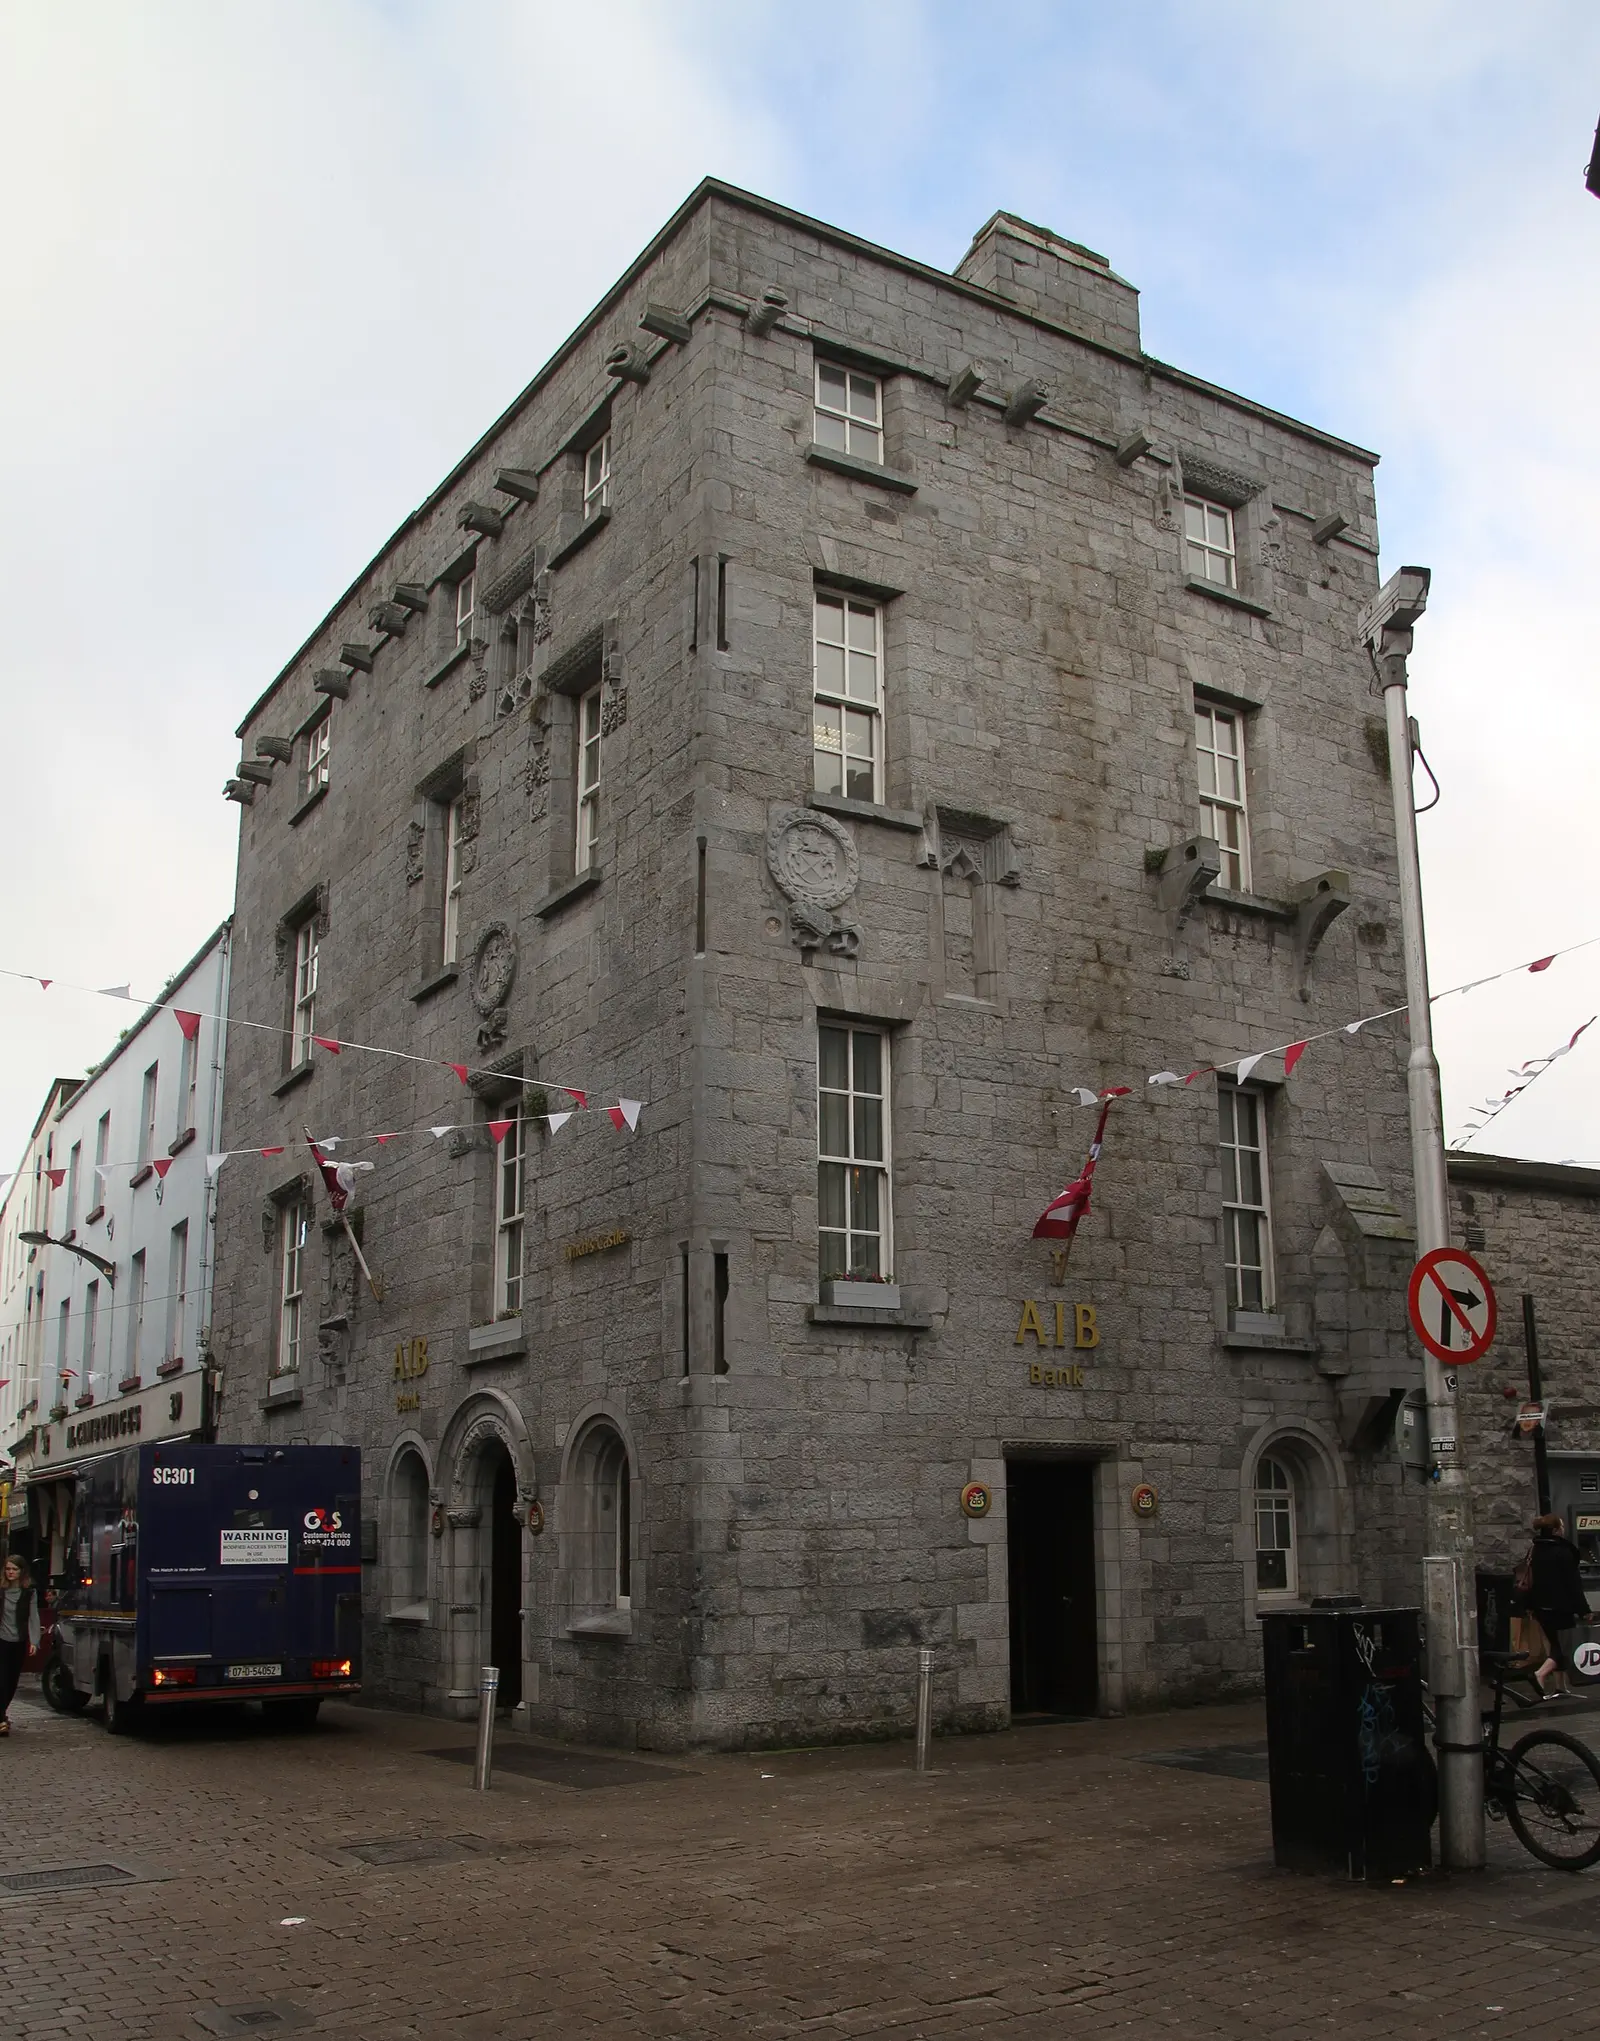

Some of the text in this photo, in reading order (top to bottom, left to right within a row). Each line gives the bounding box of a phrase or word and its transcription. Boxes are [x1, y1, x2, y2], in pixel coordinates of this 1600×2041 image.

[597, 1229, 626, 1250] Castle
[1014, 1300, 1100, 1349] AIB
[390, 1336, 429, 1381] AIB
[1029, 1363, 1085, 1388] Bank
[396, 1391, 420, 1413] Bank
[153, 1467, 195, 1485] SC301
[303, 1508, 343, 1532] G4S
[223, 1532, 287, 1541] WARNING!
[303, 1531, 351, 1539] Customer Service
[322, 1539, 335, 1547] 474
[337, 1539, 351, 1547] 000
[1580, 1650, 1600, 1668] JD
